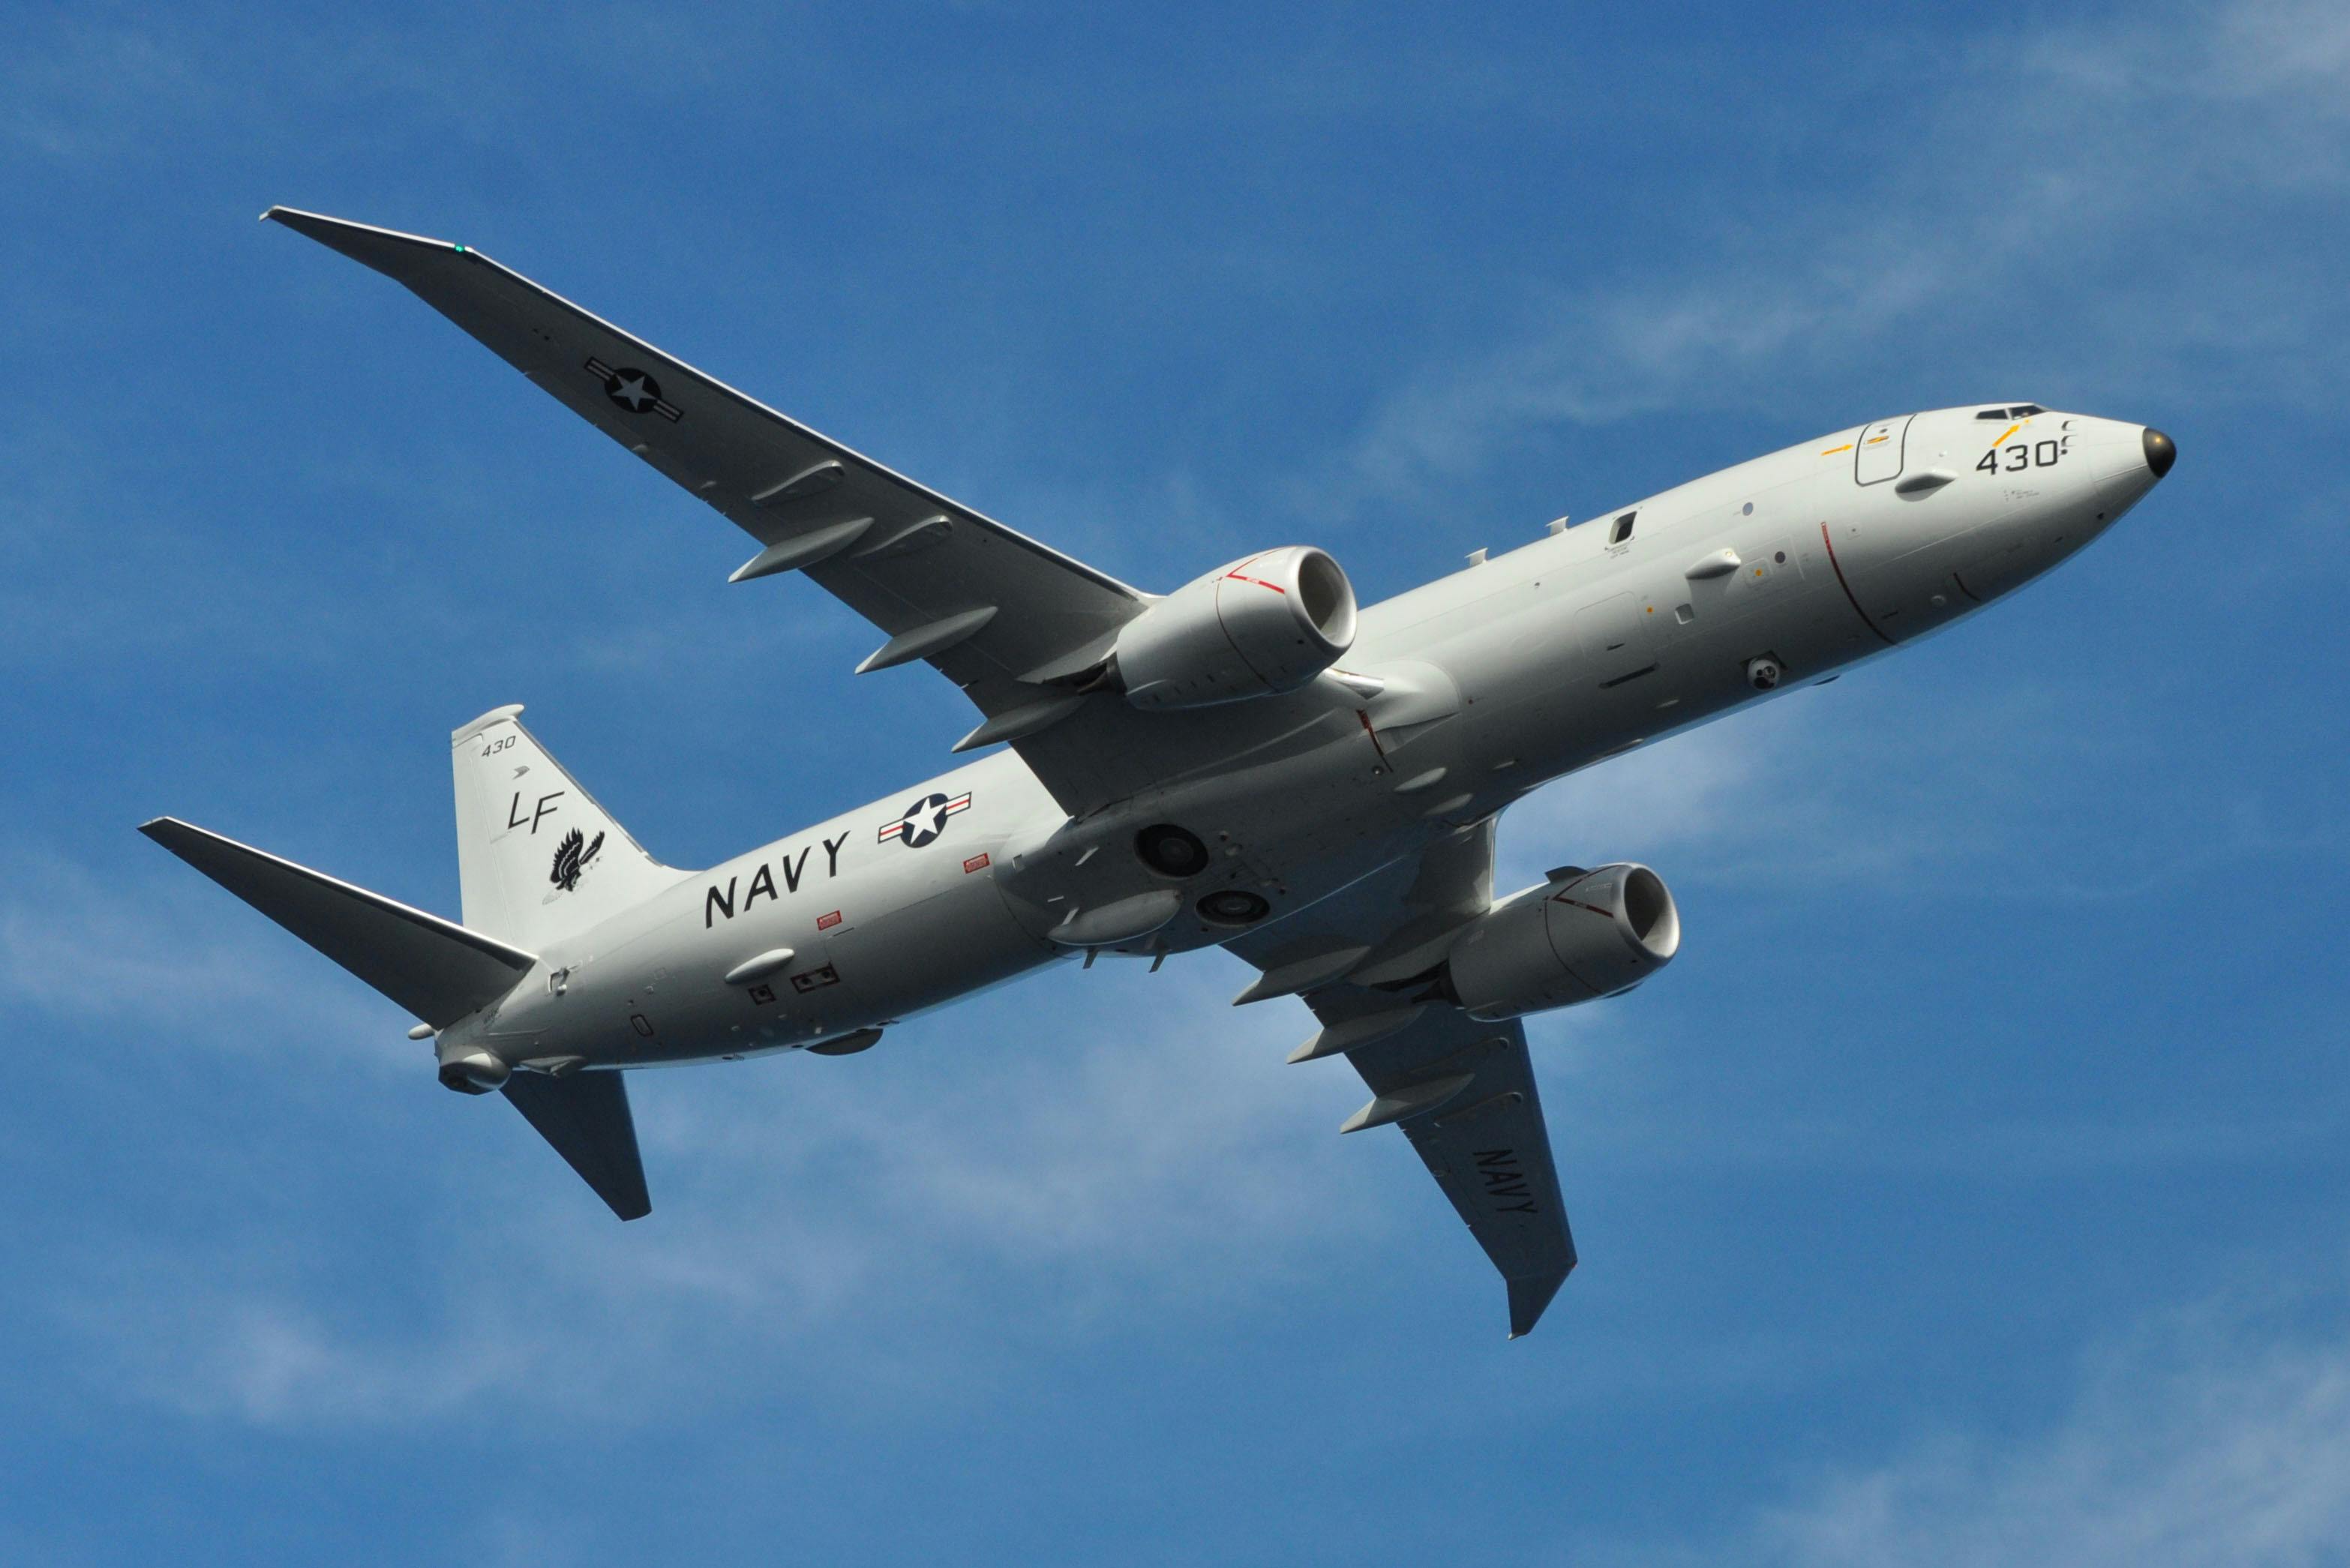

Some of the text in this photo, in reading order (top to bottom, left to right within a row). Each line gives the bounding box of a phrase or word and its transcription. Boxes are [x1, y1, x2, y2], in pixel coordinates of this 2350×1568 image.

[1976, 439, 2059, 475] 430
[481, 735, 516, 757] 430
[507, 790, 565, 835] LF
[705, 830, 851, 929] NAVY
[1472, 1149, 1538, 1213] NAVY
